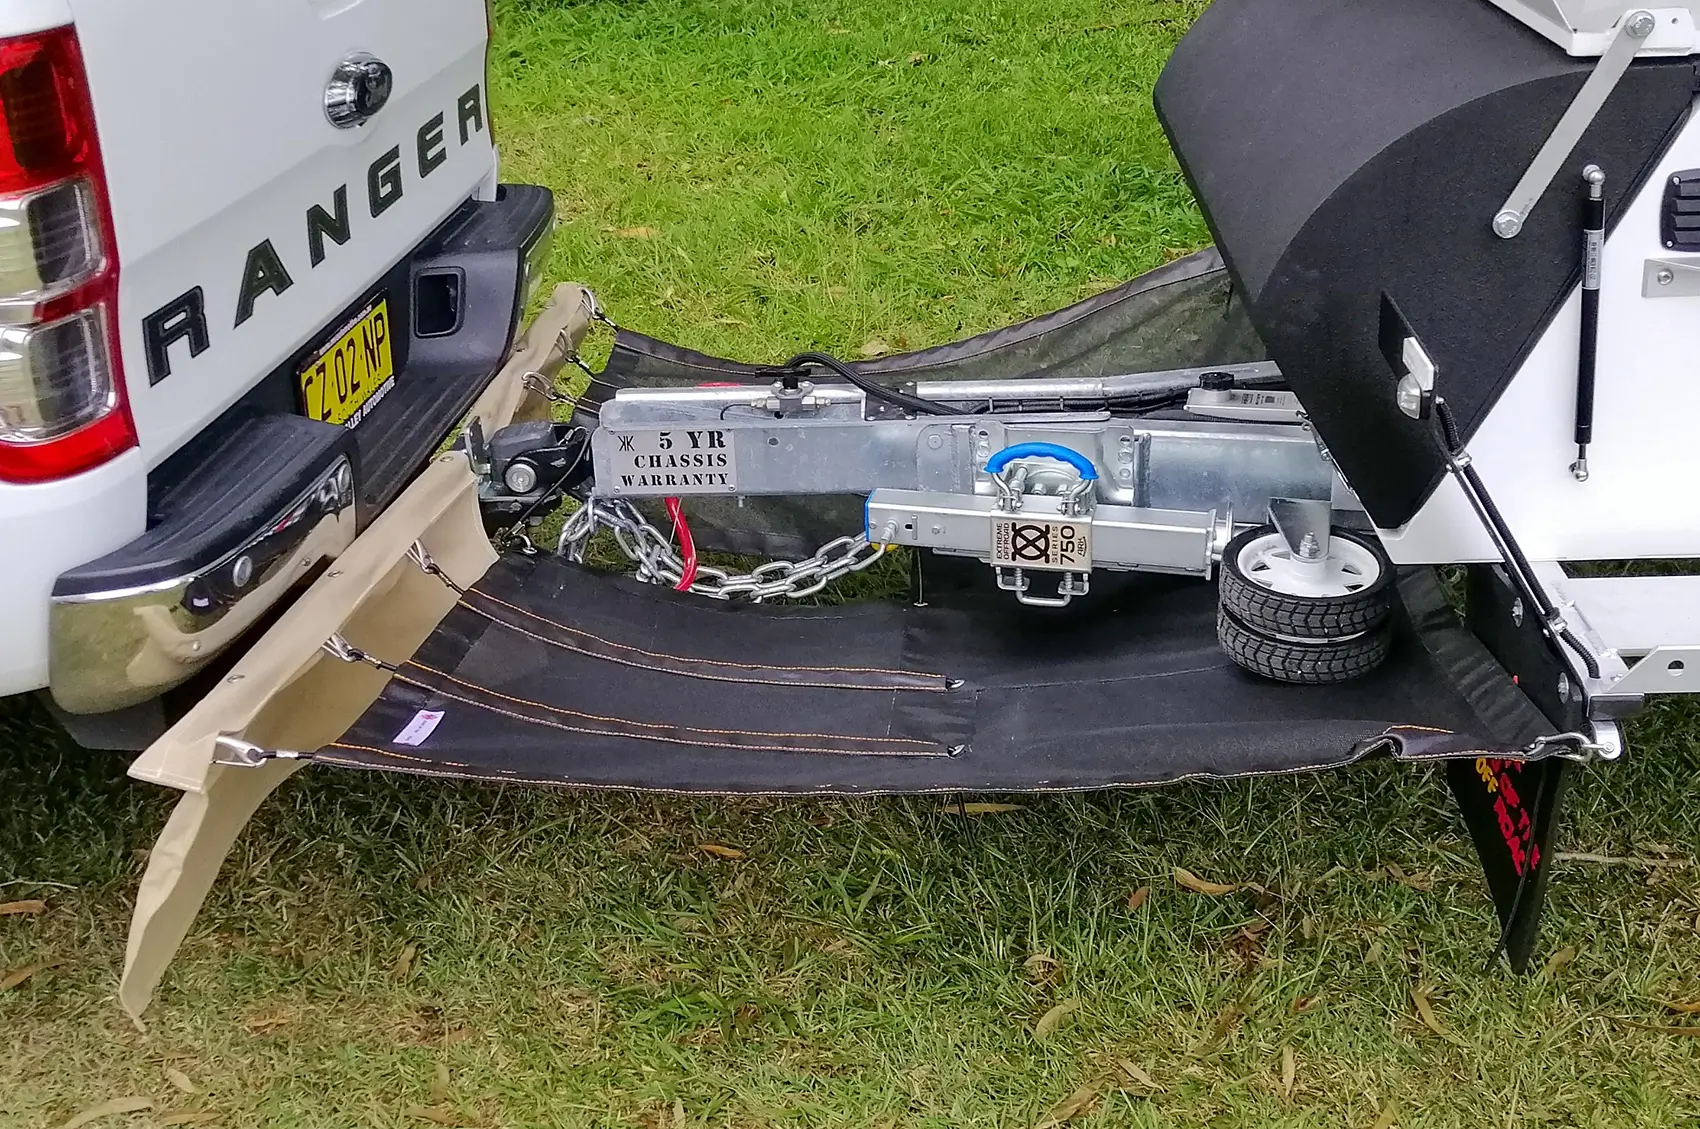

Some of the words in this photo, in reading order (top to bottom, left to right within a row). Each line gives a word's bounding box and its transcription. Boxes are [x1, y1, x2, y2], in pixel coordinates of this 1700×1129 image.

[142, 83, 484, 387] RANGER
[362, 375, 396, 417] AUTOMOTIVE
[659, 432, 673, 449] 5
[686, 431, 727, 449] YR
[634, 454, 728, 468] CHASSIS
[621, 473, 729, 487] WARRANTY
[1060, 525, 1076, 566] 750
